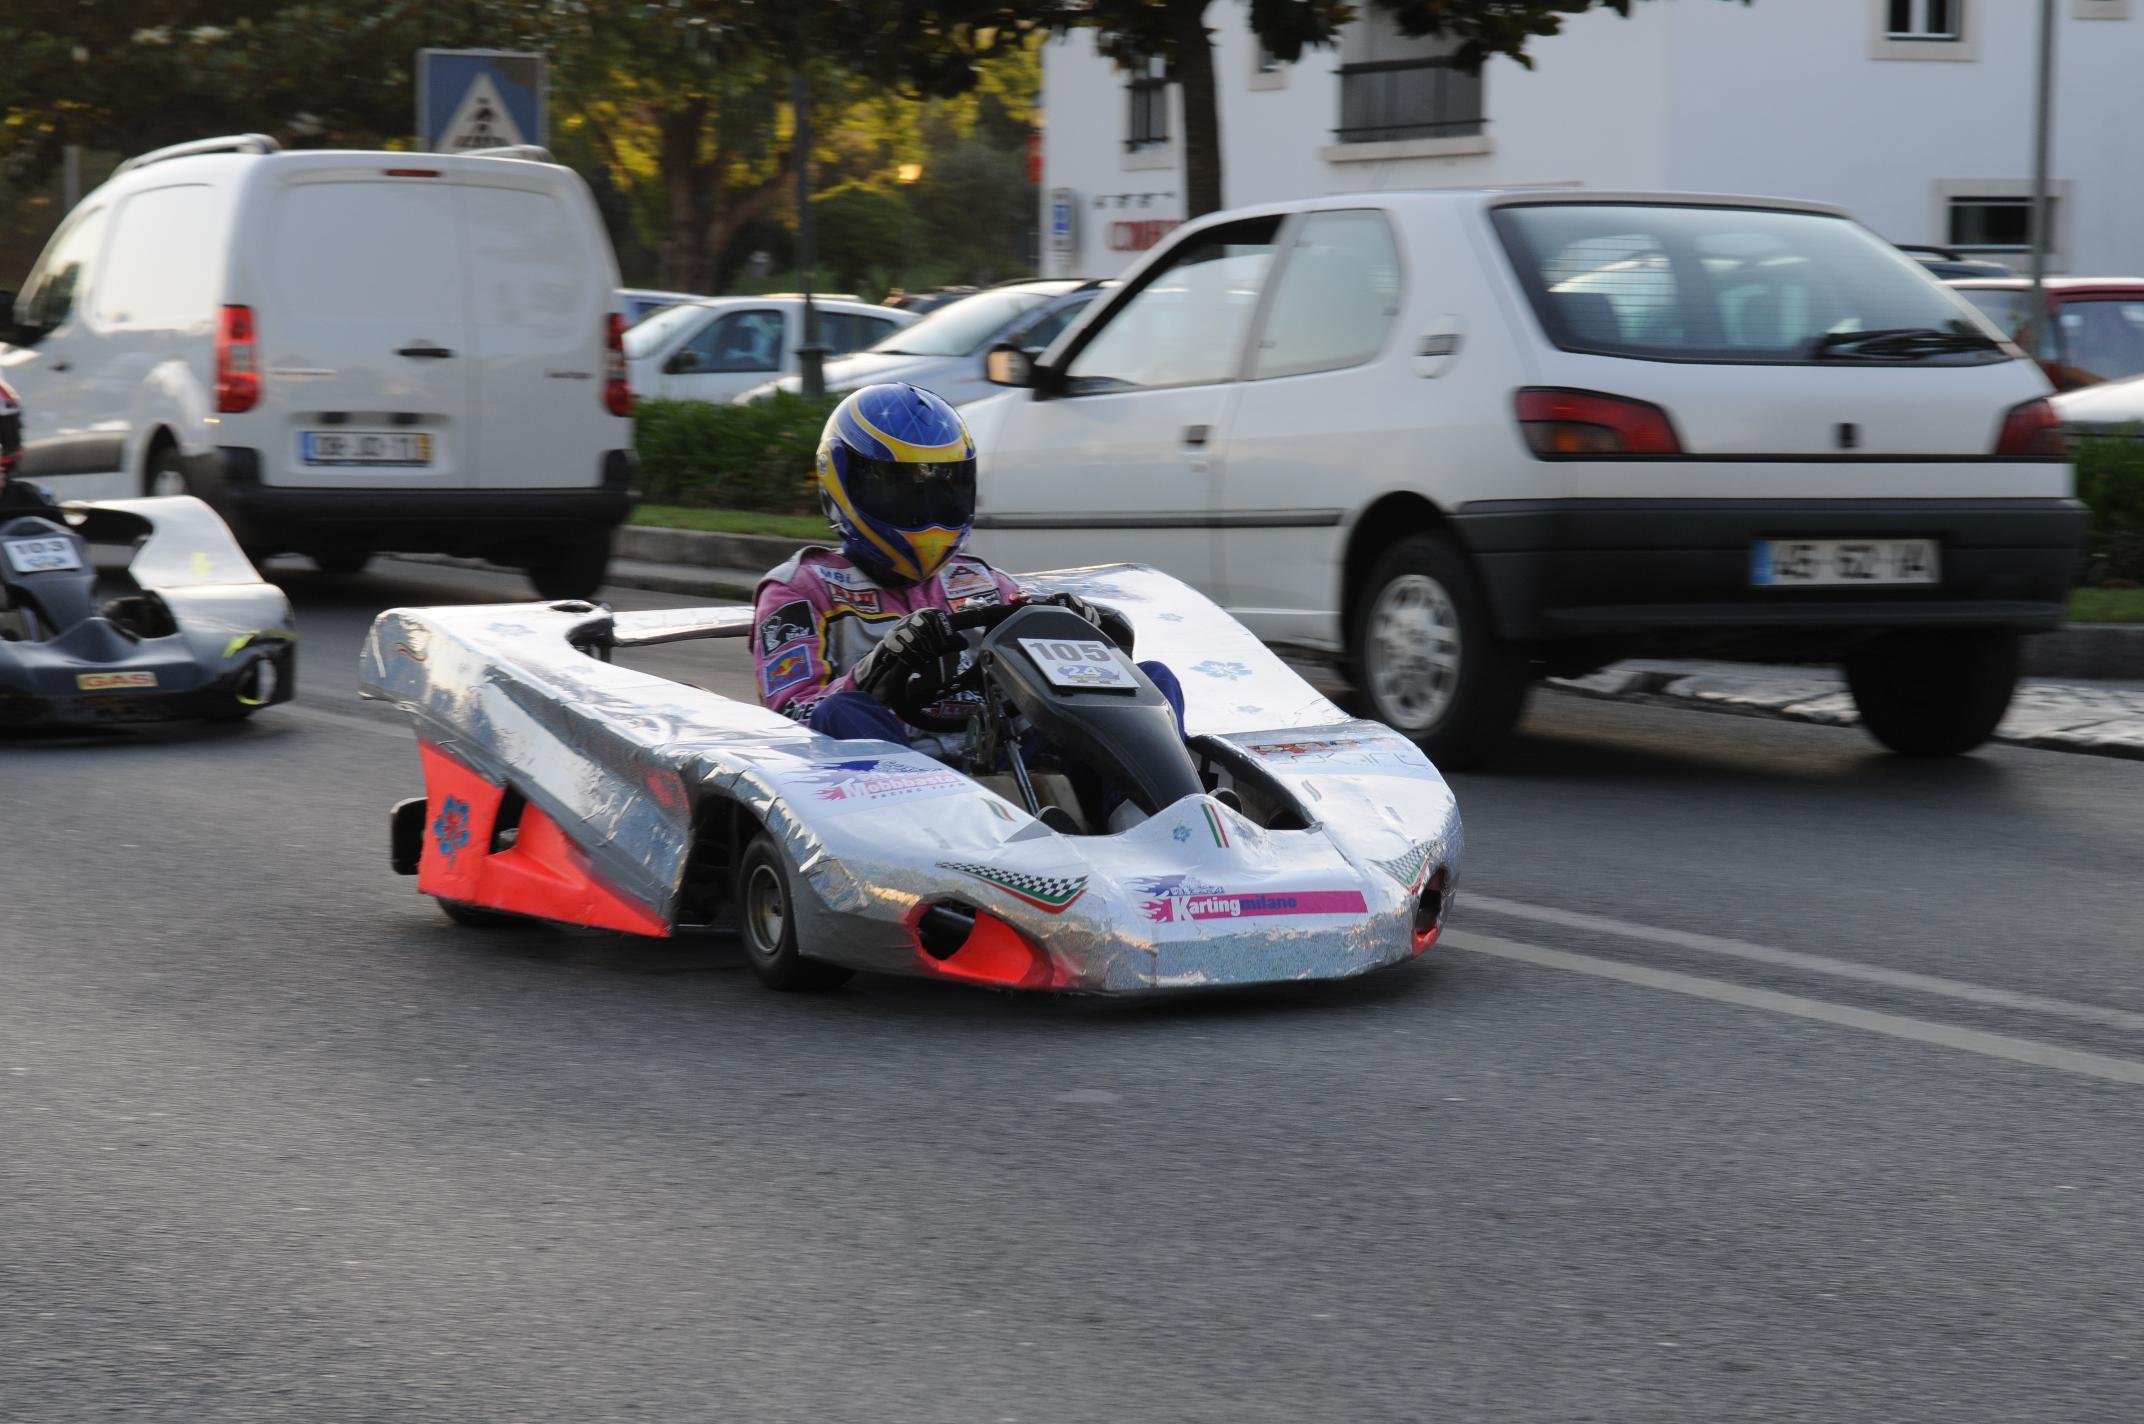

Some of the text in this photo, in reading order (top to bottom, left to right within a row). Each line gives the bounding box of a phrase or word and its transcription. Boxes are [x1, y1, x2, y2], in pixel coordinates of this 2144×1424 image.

[14, 540, 66, 554] 103
[1029, 642, 1112, 662] 105
[1068, 665, 1102, 676] 24
[84, 674, 153, 688] GAS
